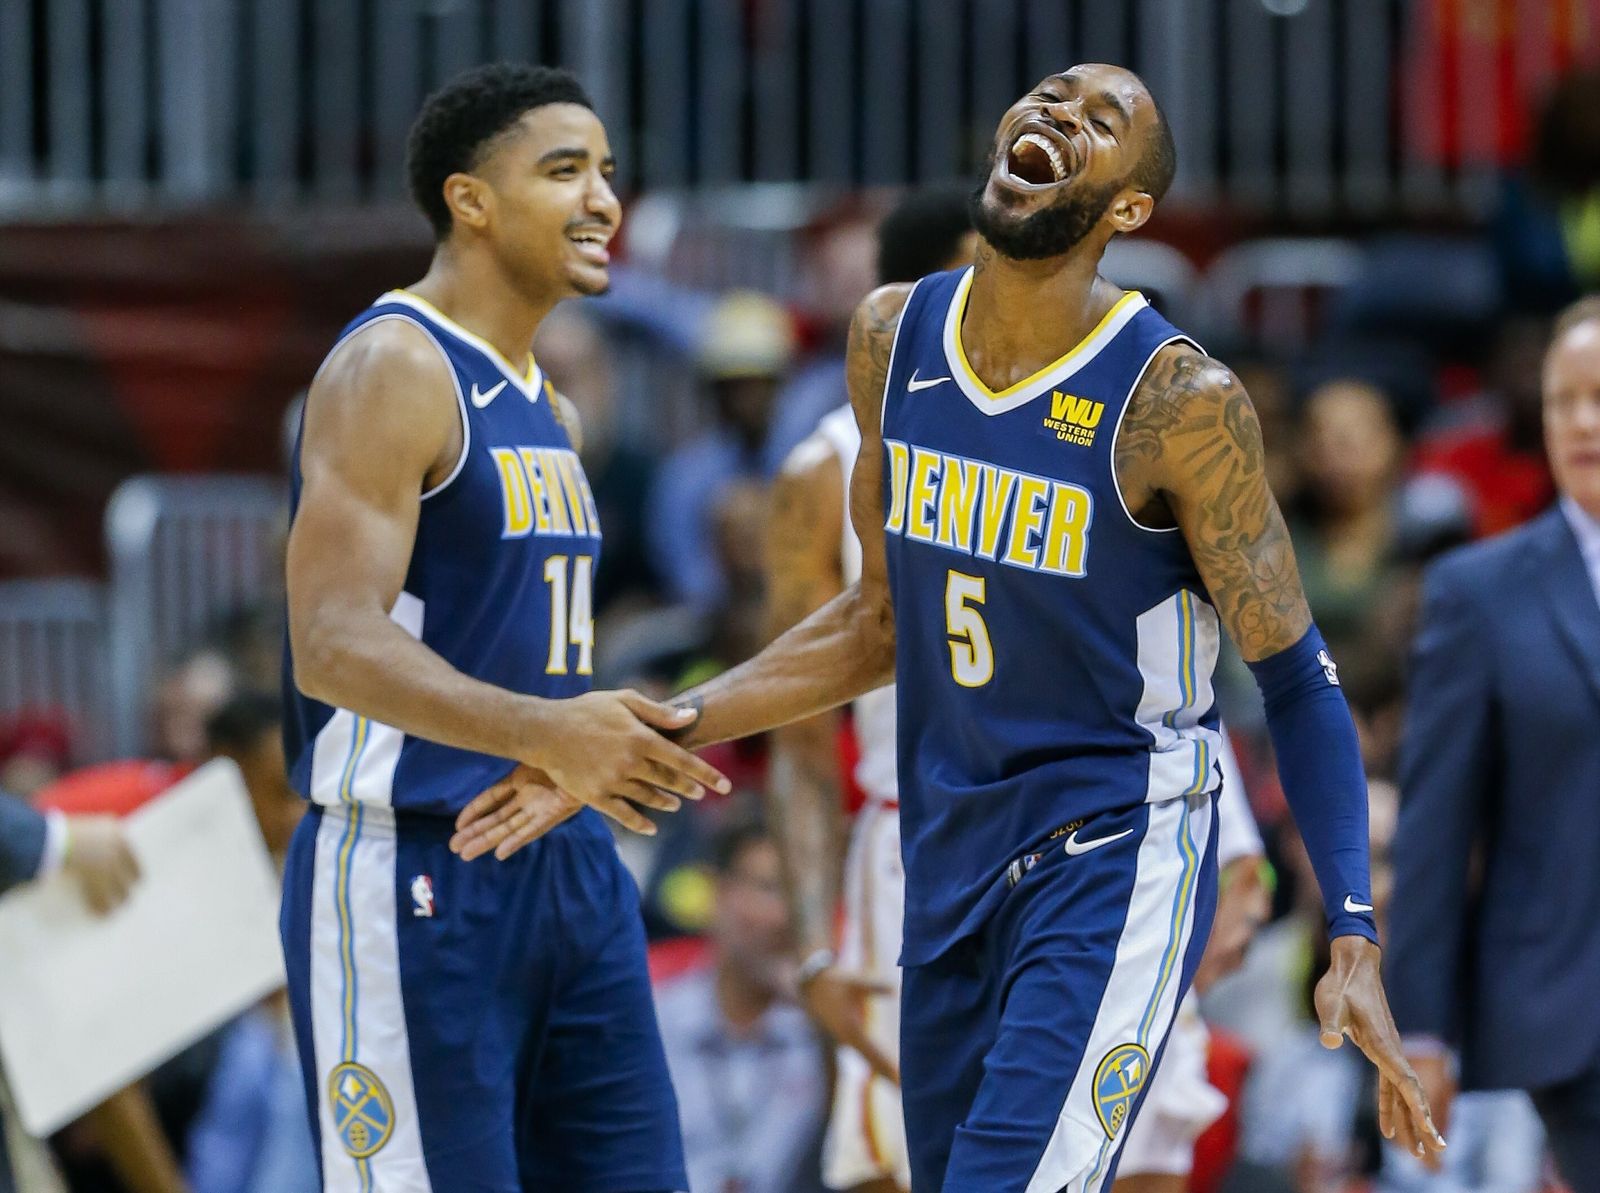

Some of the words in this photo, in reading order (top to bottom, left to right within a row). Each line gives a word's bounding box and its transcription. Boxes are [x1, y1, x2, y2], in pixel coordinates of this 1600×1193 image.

[1043, 418, 1096, 439] WESTERN
[1050, 390, 1105, 429] WU
[1056, 430, 1093, 447] UNION
[883, 438, 1095, 579] DENVER
[543, 555, 595, 676] 14
[944, 569, 995, 688] 5
